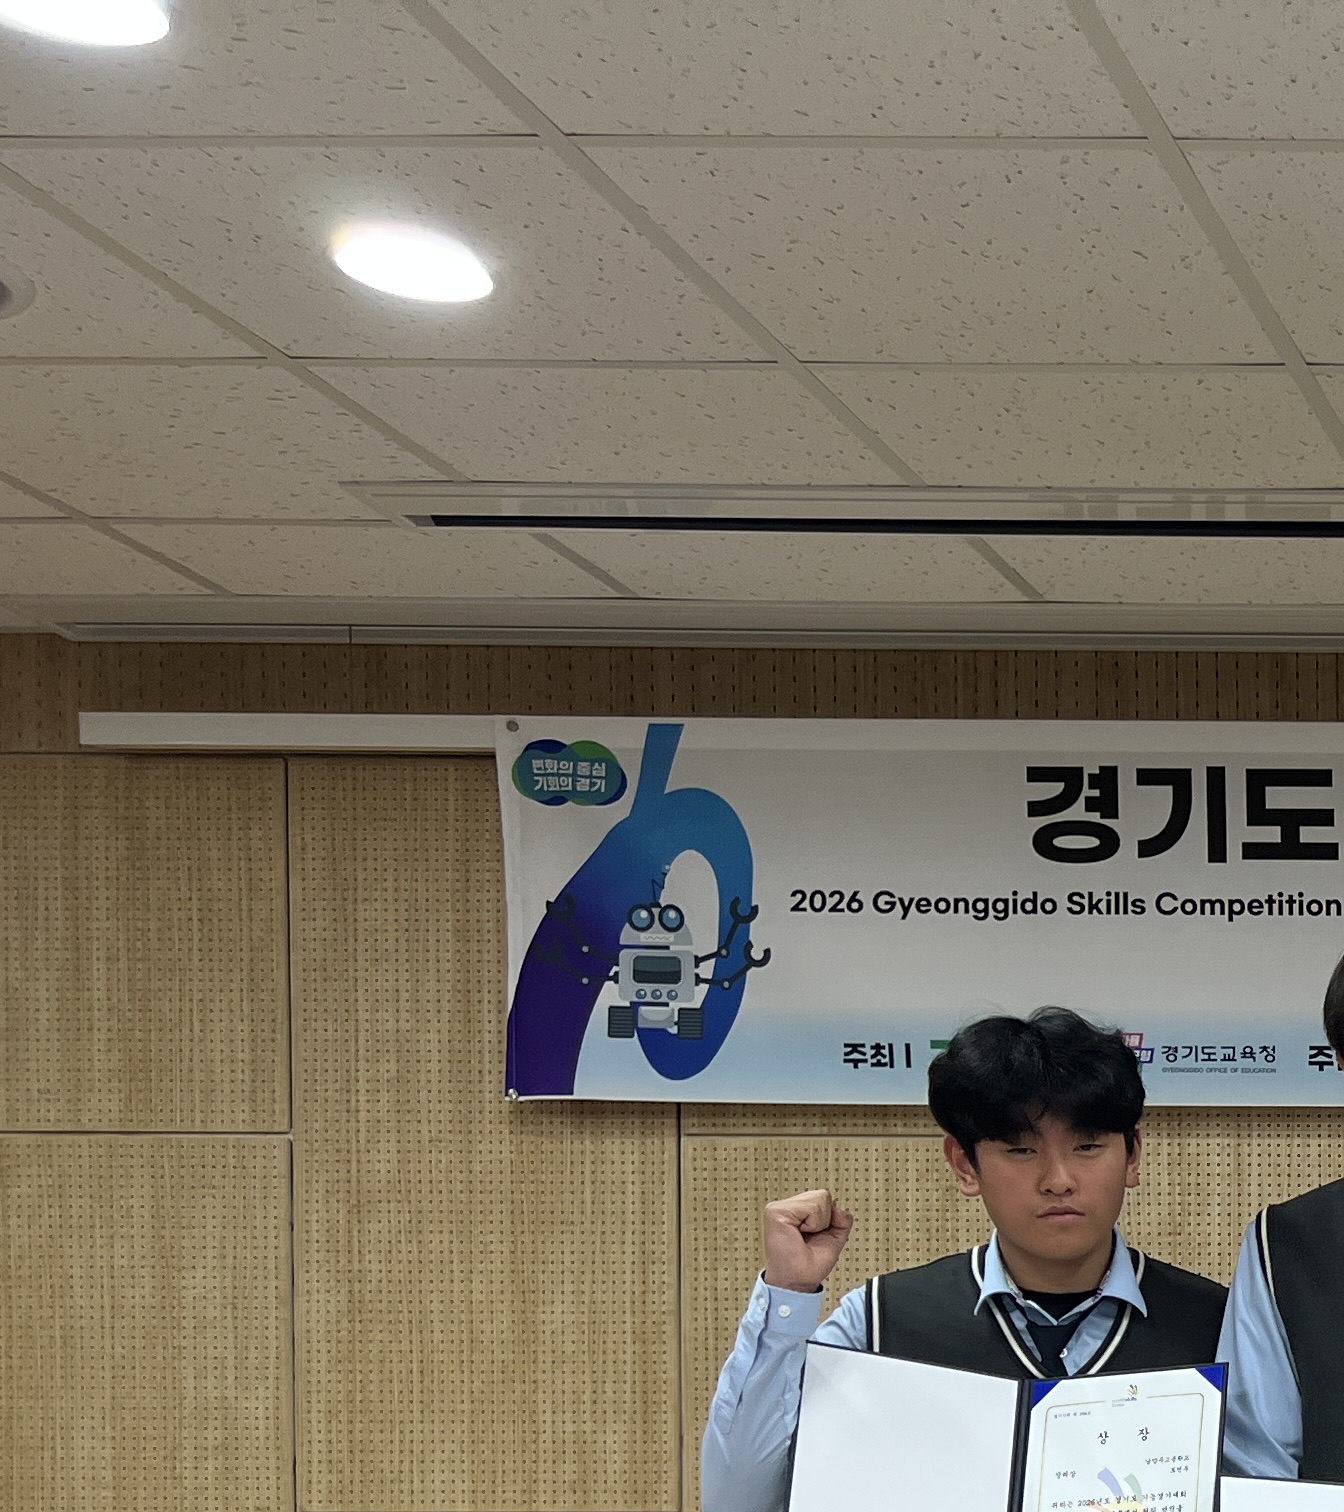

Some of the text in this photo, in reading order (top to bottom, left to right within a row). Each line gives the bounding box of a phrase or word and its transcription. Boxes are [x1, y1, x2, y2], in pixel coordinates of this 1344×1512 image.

[533, 776, 573, 791] 기회의
[1026, 765, 1340, 864] 경기도
[789, 889, 1343, 923] 2026 Gyeonggido Skills Competition
[1161, 1044, 1277, 1063] 경기도교육청
